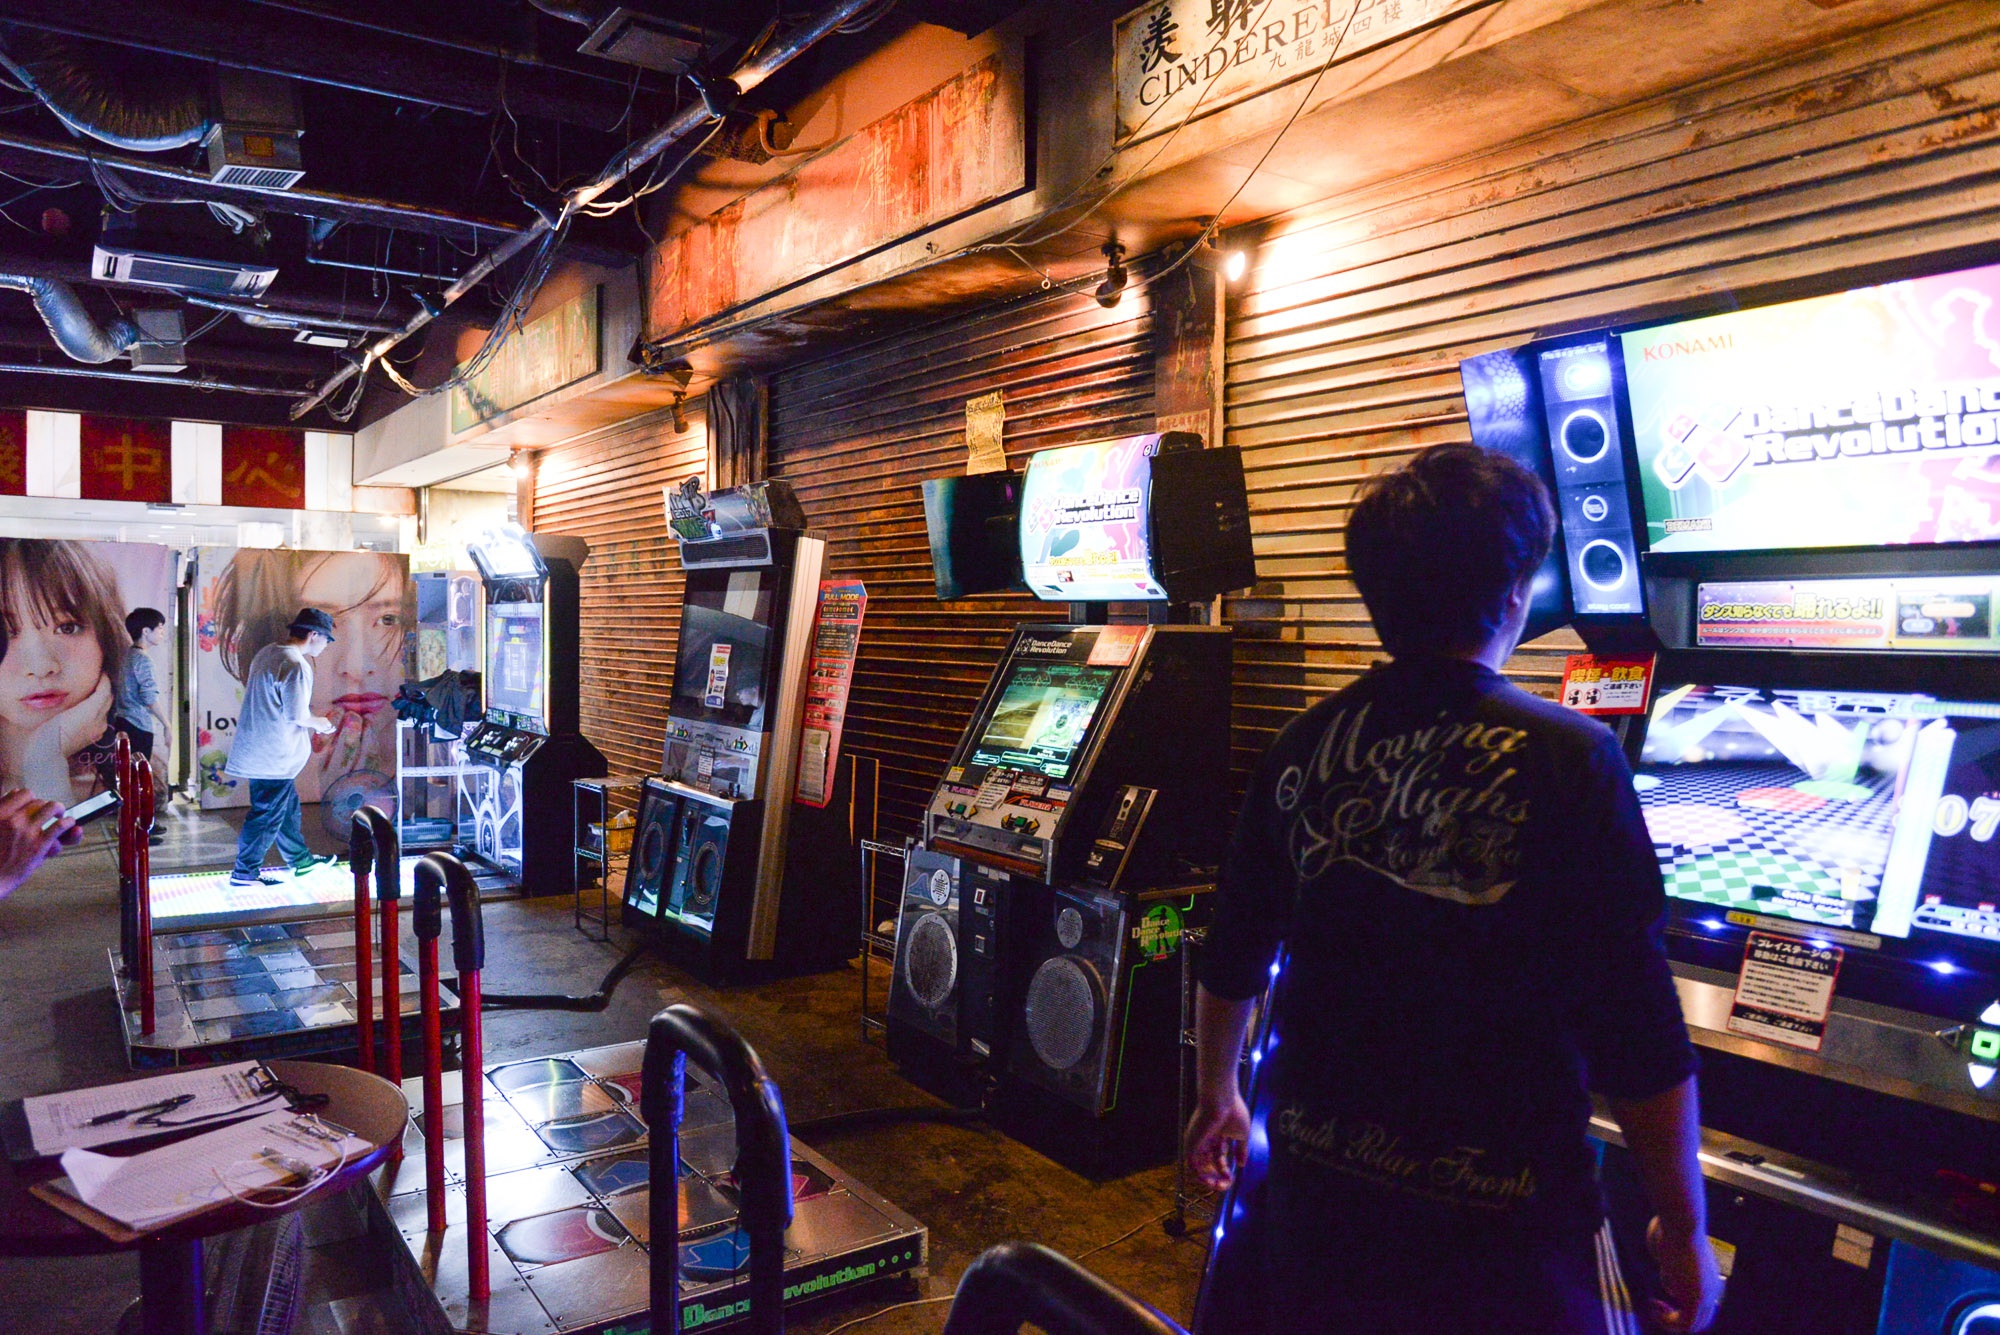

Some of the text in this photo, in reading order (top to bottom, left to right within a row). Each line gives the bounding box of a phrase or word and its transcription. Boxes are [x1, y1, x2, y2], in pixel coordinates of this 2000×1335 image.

[1643, 333, 1734, 362] KONAMI
[1748, 412, 2000, 466] Revolutio
[1055, 505, 1136, 525] Revolution
[840, 593, 860, 601] MODE
[1029, 645, 1068, 654] Revolution
[1031, 638, 1073, 648] DanceDance
[783, 1261, 876, 1300] evolution
